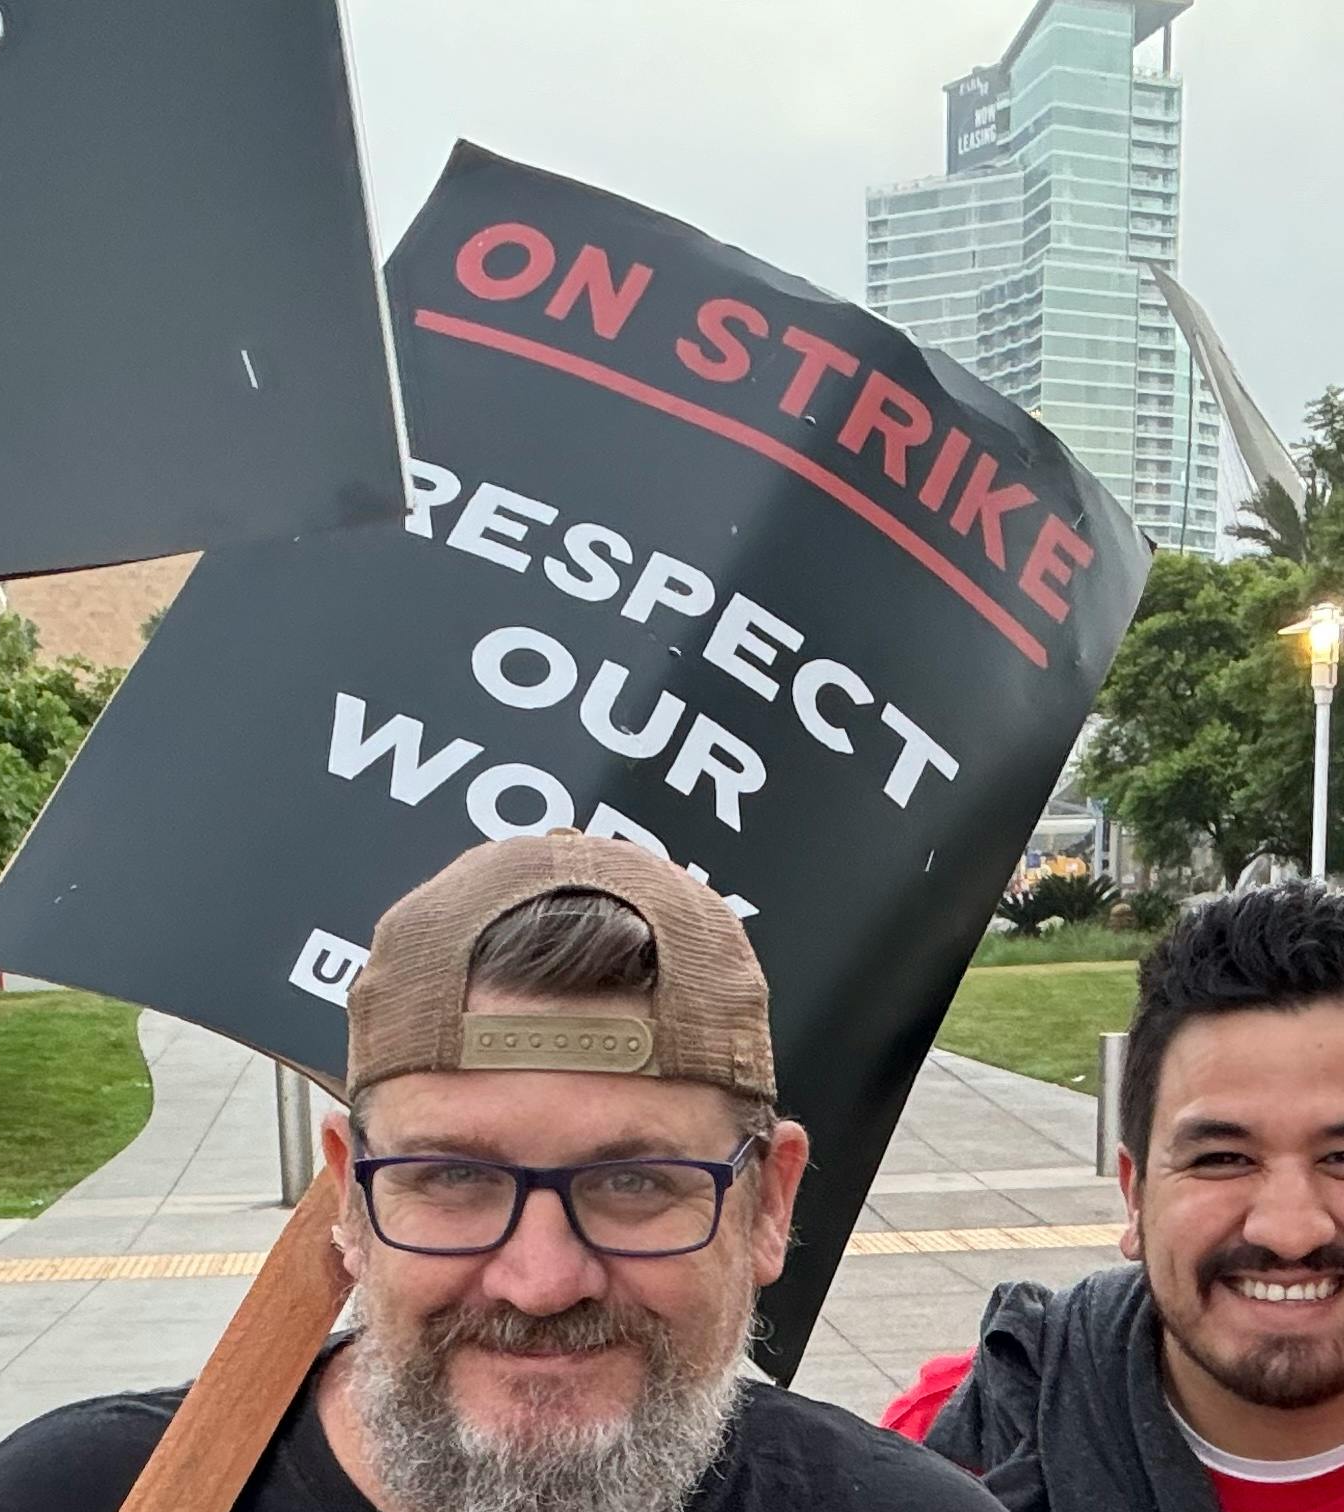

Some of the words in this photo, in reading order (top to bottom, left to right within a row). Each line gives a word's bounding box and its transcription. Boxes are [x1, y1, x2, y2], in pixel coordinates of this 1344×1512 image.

[456, 222, 653, 340] ON
[676, 297, 1096, 623] STRIKE
[404, 457, 959, 810] RESPECT
[472, 626, 767, 833] OUR
[328, 691, 760, 922] WO
